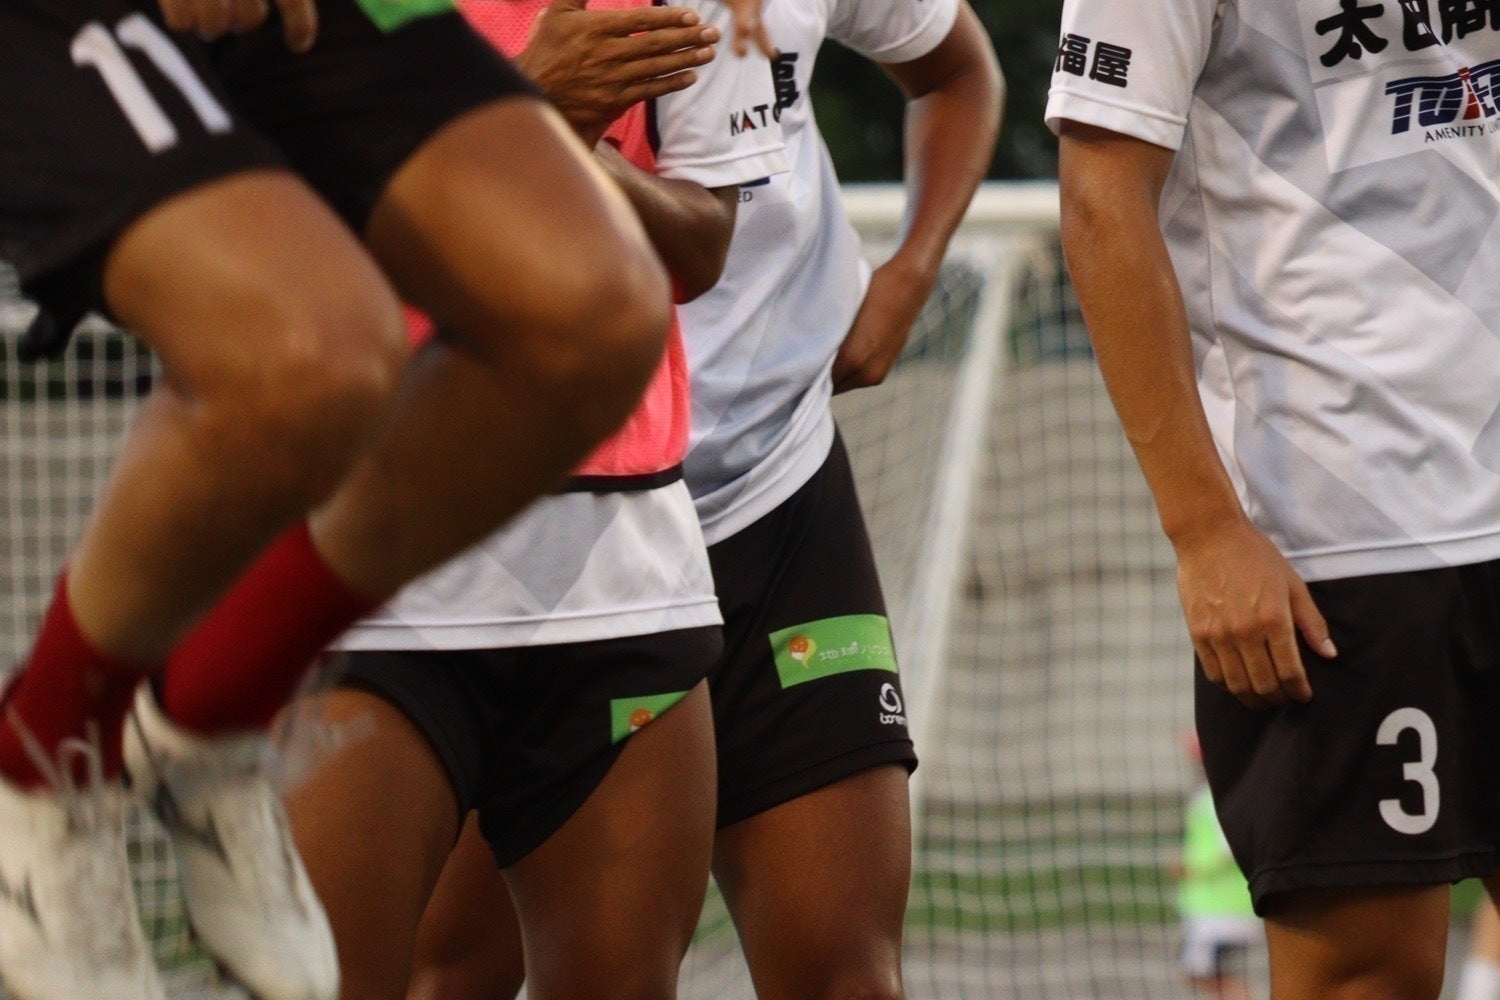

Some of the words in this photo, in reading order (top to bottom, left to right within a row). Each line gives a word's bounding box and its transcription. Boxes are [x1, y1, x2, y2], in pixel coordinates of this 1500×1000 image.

[69, 12, 233, 154] 11
[1424, 124, 1485, 143] AMENITY
[1375, 706, 1441, 835] 3
